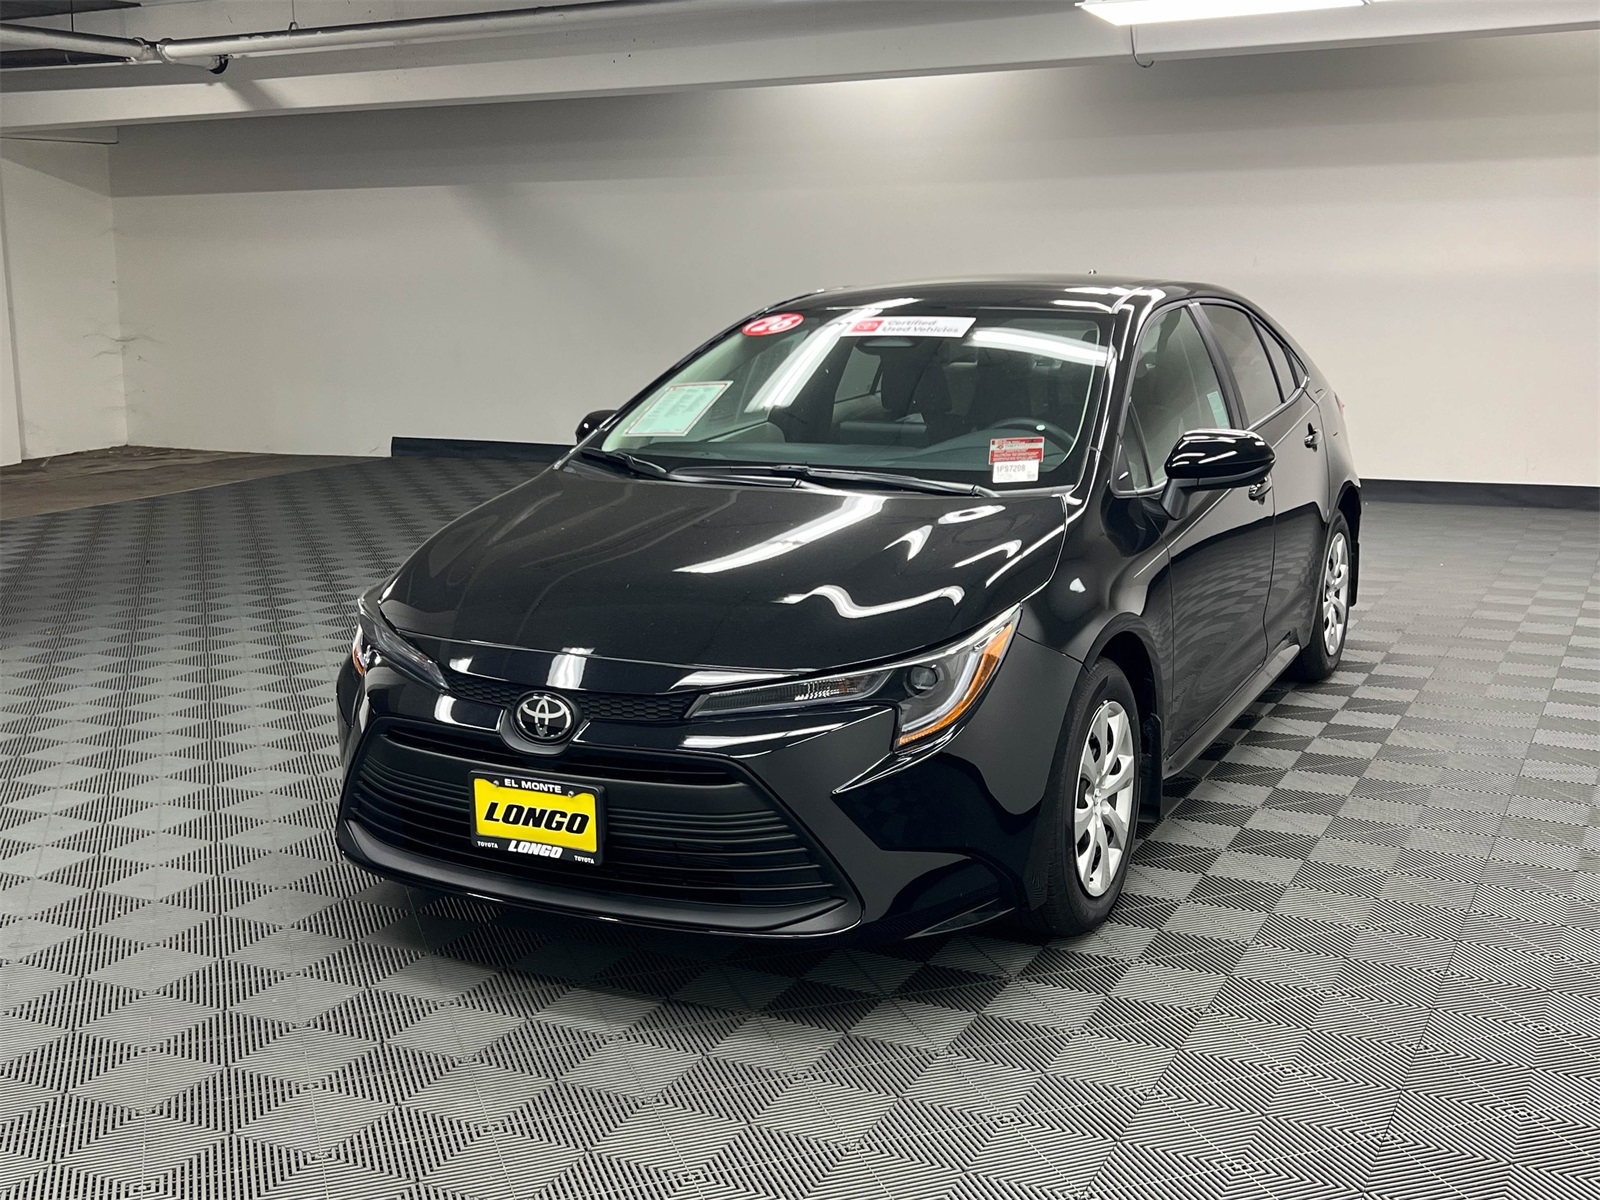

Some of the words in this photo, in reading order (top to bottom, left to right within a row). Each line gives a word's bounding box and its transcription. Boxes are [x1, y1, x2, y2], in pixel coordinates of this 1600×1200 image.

[887, 319, 937, 327] Certified
[996, 464, 1026, 473] 1PS7208
[504, 778, 519, 788] EL
[521, 780, 562, 794] MONTE
[483, 801, 590, 835] LONGO
[476, 841, 499, 849] TOYOTA
[507, 839, 563, 859] LONGO
[573, 855, 595, 865] TOYOTA
